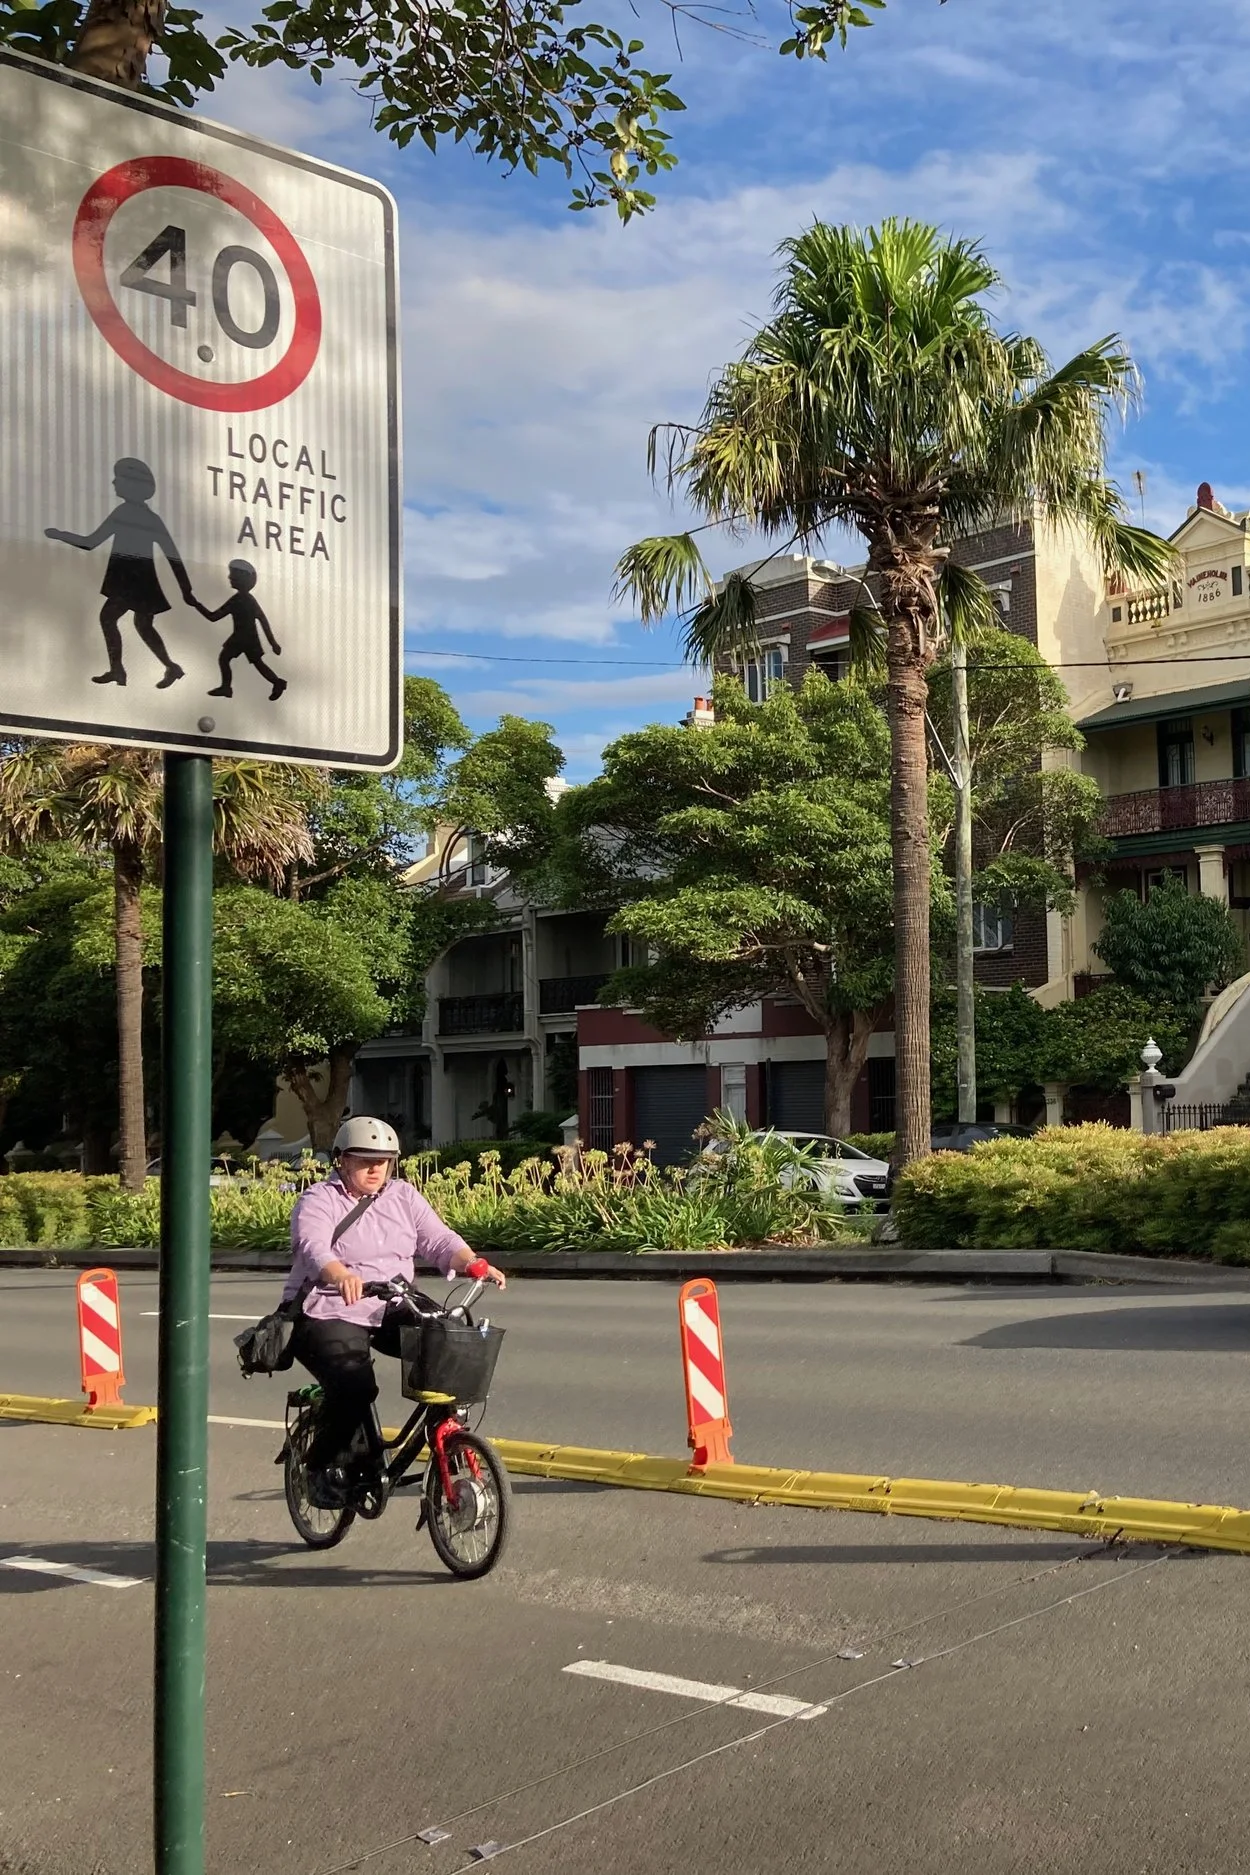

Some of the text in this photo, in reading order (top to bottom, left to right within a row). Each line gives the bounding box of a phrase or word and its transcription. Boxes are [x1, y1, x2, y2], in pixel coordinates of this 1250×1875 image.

[120, 225, 280, 349] 40
[227, 427, 337, 480] LOCAL
[207, 466, 347, 524] TRAFFIC
[237, 524, 330, 561] AREA
[1198, 588, 1221, 603] 1886
